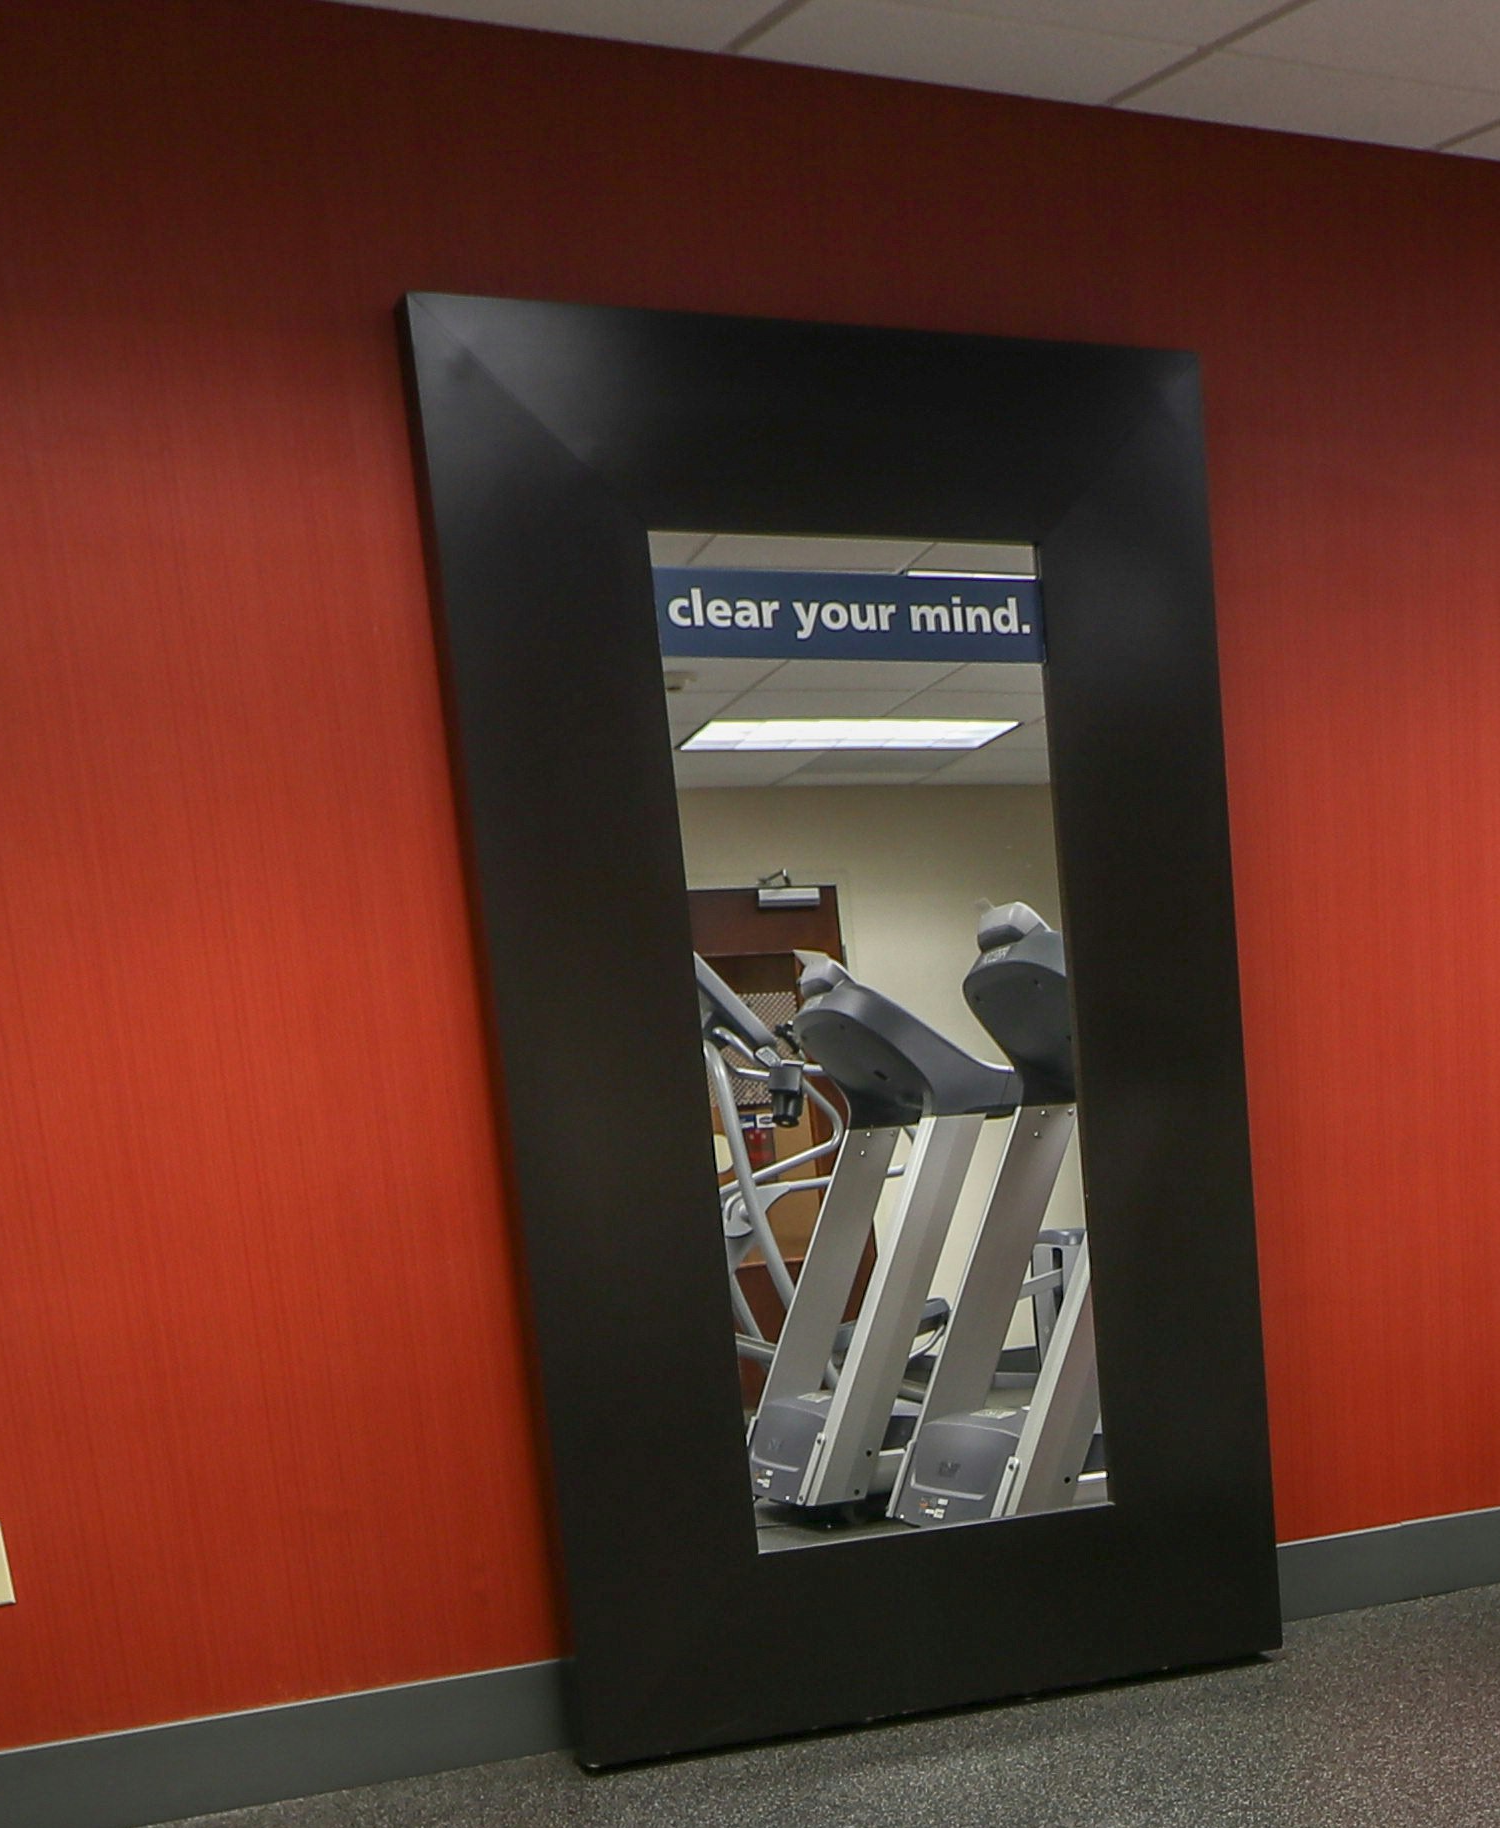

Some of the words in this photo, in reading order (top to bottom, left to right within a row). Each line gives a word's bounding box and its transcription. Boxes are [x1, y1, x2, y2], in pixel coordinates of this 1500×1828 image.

[668, 588, 779, 628] clear
[792, 600, 895, 639] your
[910, 596, 1031, 634] mind.
